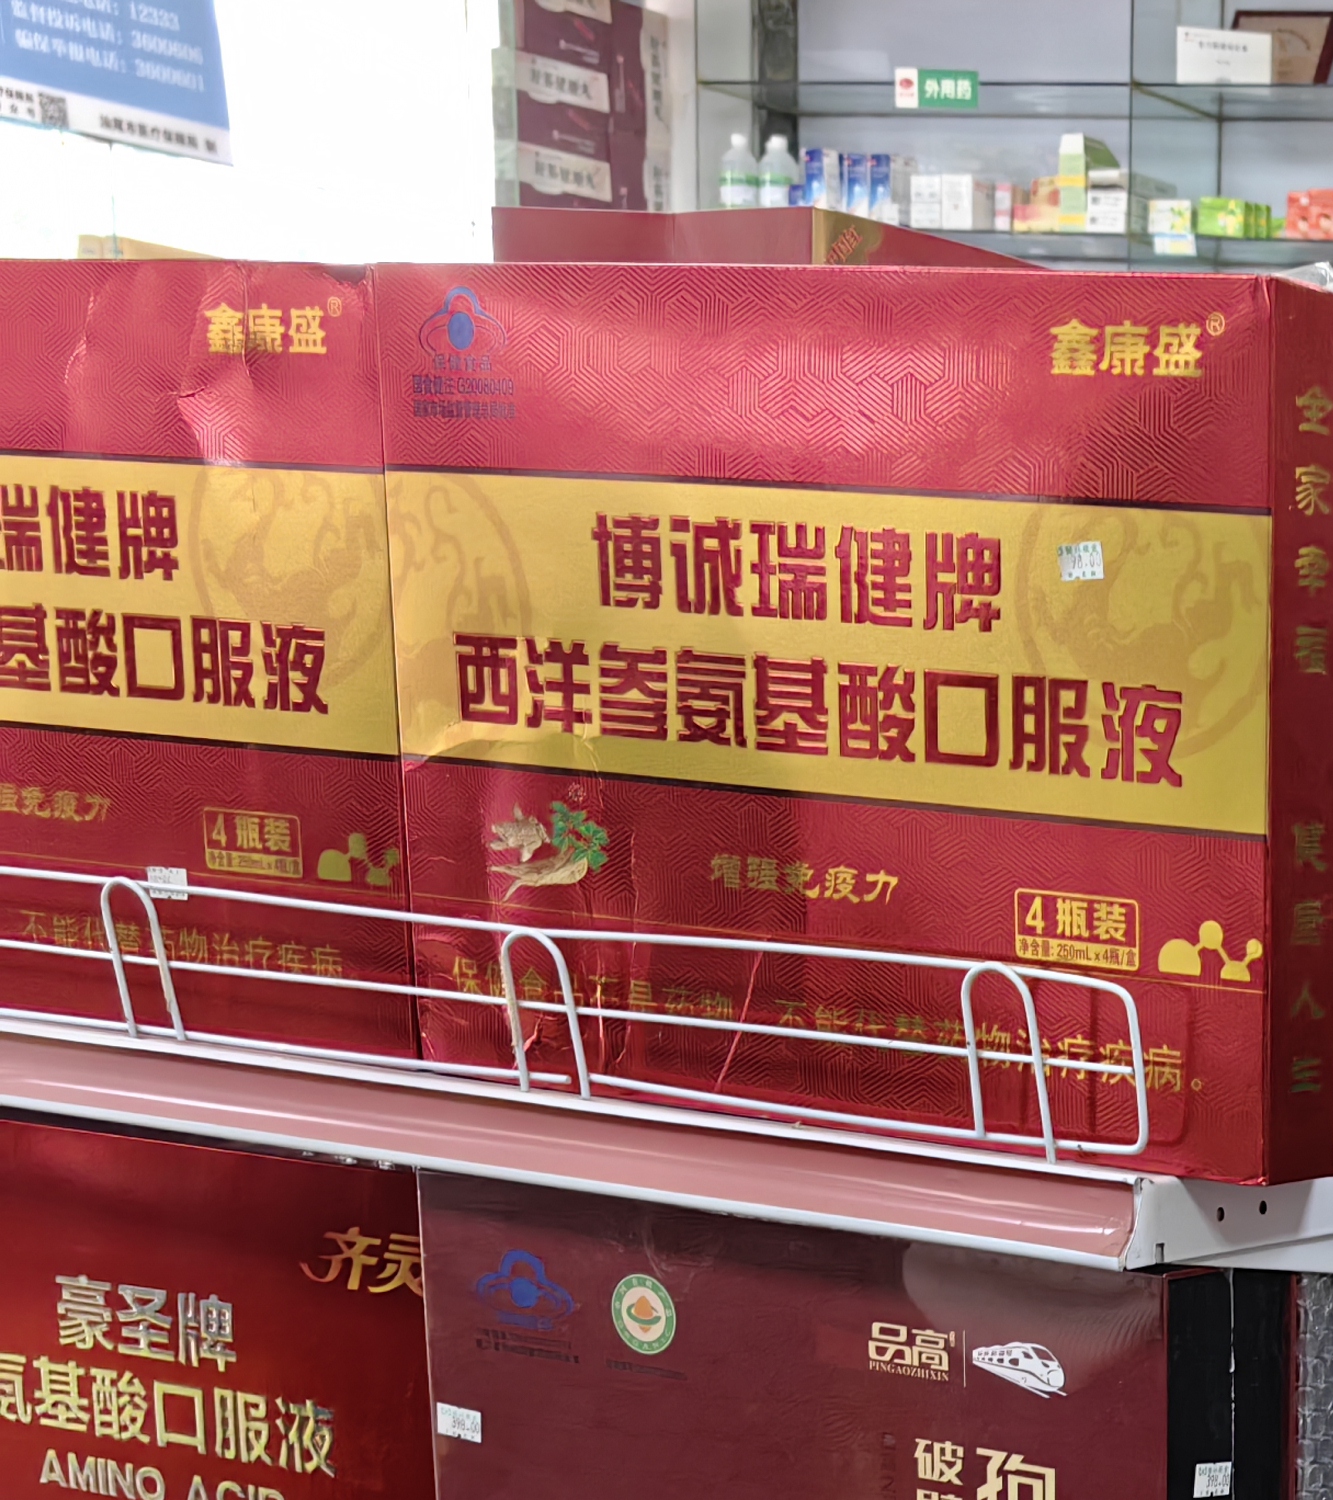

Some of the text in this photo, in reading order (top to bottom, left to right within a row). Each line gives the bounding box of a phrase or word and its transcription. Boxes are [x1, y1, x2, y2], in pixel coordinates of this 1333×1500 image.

[924, 79, 972, 102] 外用药
[204, 301, 328, 355] 鑫康盛
[1050, 317, 1203, 378] 鑫康盛
[591, 511, 1002, 634] 博诚瑞健牌
[55, 1273, 238, 1372] 豪圣牌
